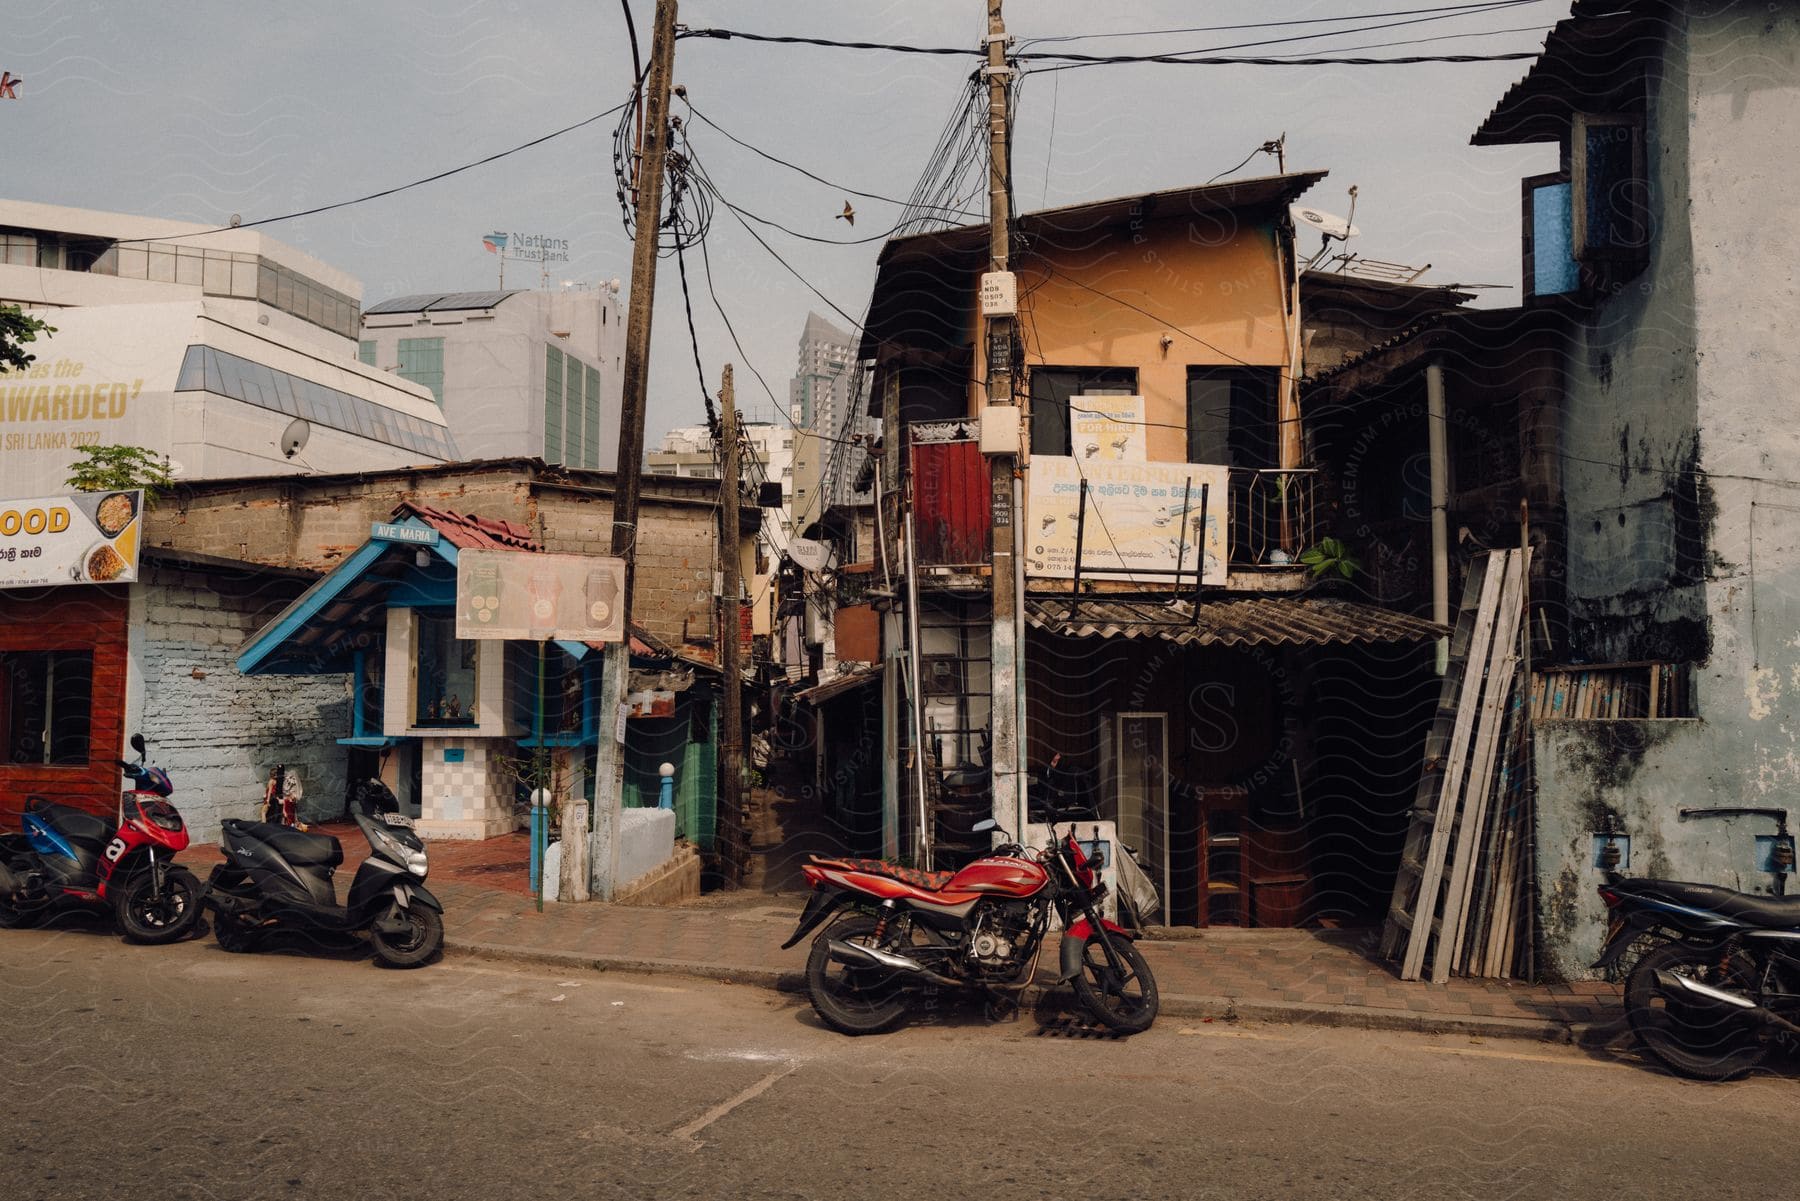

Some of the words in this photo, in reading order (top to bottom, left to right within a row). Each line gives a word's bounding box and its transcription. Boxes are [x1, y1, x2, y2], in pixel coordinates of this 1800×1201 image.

[0, 71, 22, 99] k
[513, 232, 569, 250] Nations
[513, 247, 542, 259] Trust
[543, 250, 569, 262] Bank
[29, 362, 51, 379] as
[53, 359, 83, 378] the
[1079, 423, 1103, 433] FOR
[1106, 423, 1133, 433] HIRE
[6, 432, 24, 451] SRI
[28, 431, 67, 450] LANKA
[70, 431, 100, 449] 2022
[377, 525, 397, 538] AVE
[400, 527, 431, 542] MARIA
[105, 838, 126, 863] a
